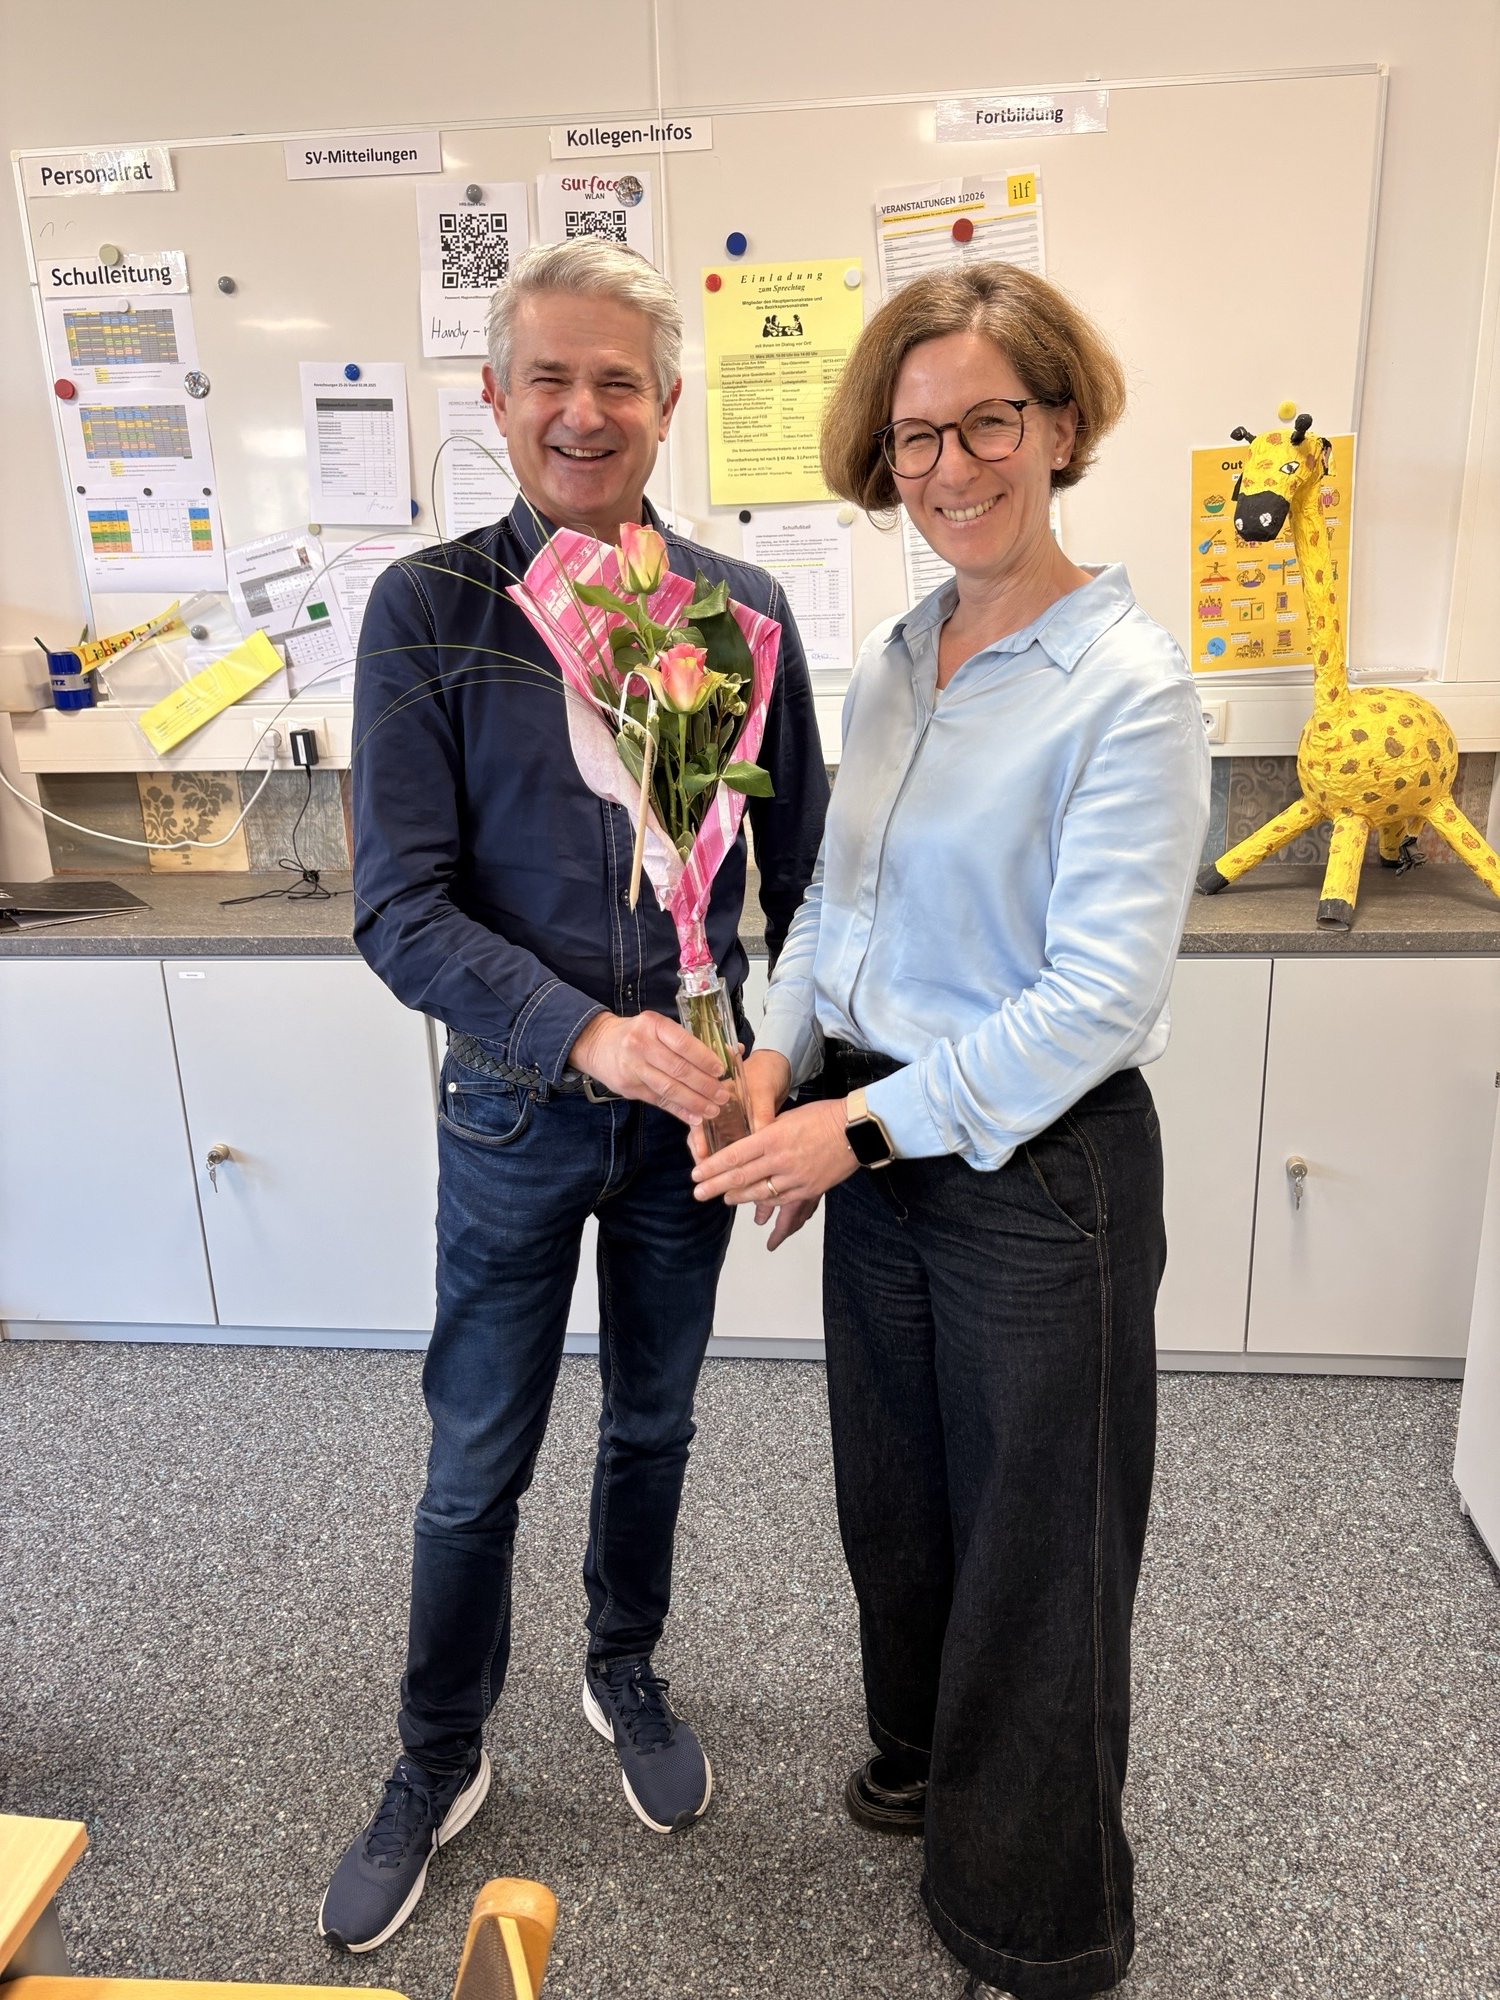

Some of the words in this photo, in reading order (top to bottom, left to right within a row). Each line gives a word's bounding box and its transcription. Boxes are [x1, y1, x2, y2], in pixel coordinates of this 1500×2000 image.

[976, 107, 1064, 125] Fortbildung
[566, 124, 693, 148] Kollegen-Infos
[305, 147, 418, 164] SV-Mitteilungen
[41, 160, 153, 186] Personalrat
[1013, 181, 1031, 200] ilf
[881, 196, 956, 214] VERANSTALTUNGEN
[51, 262, 172, 287] Schulleitung
[741, 272, 823, 283] Einladung
[773, 284, 806, 292] Sprechtag
